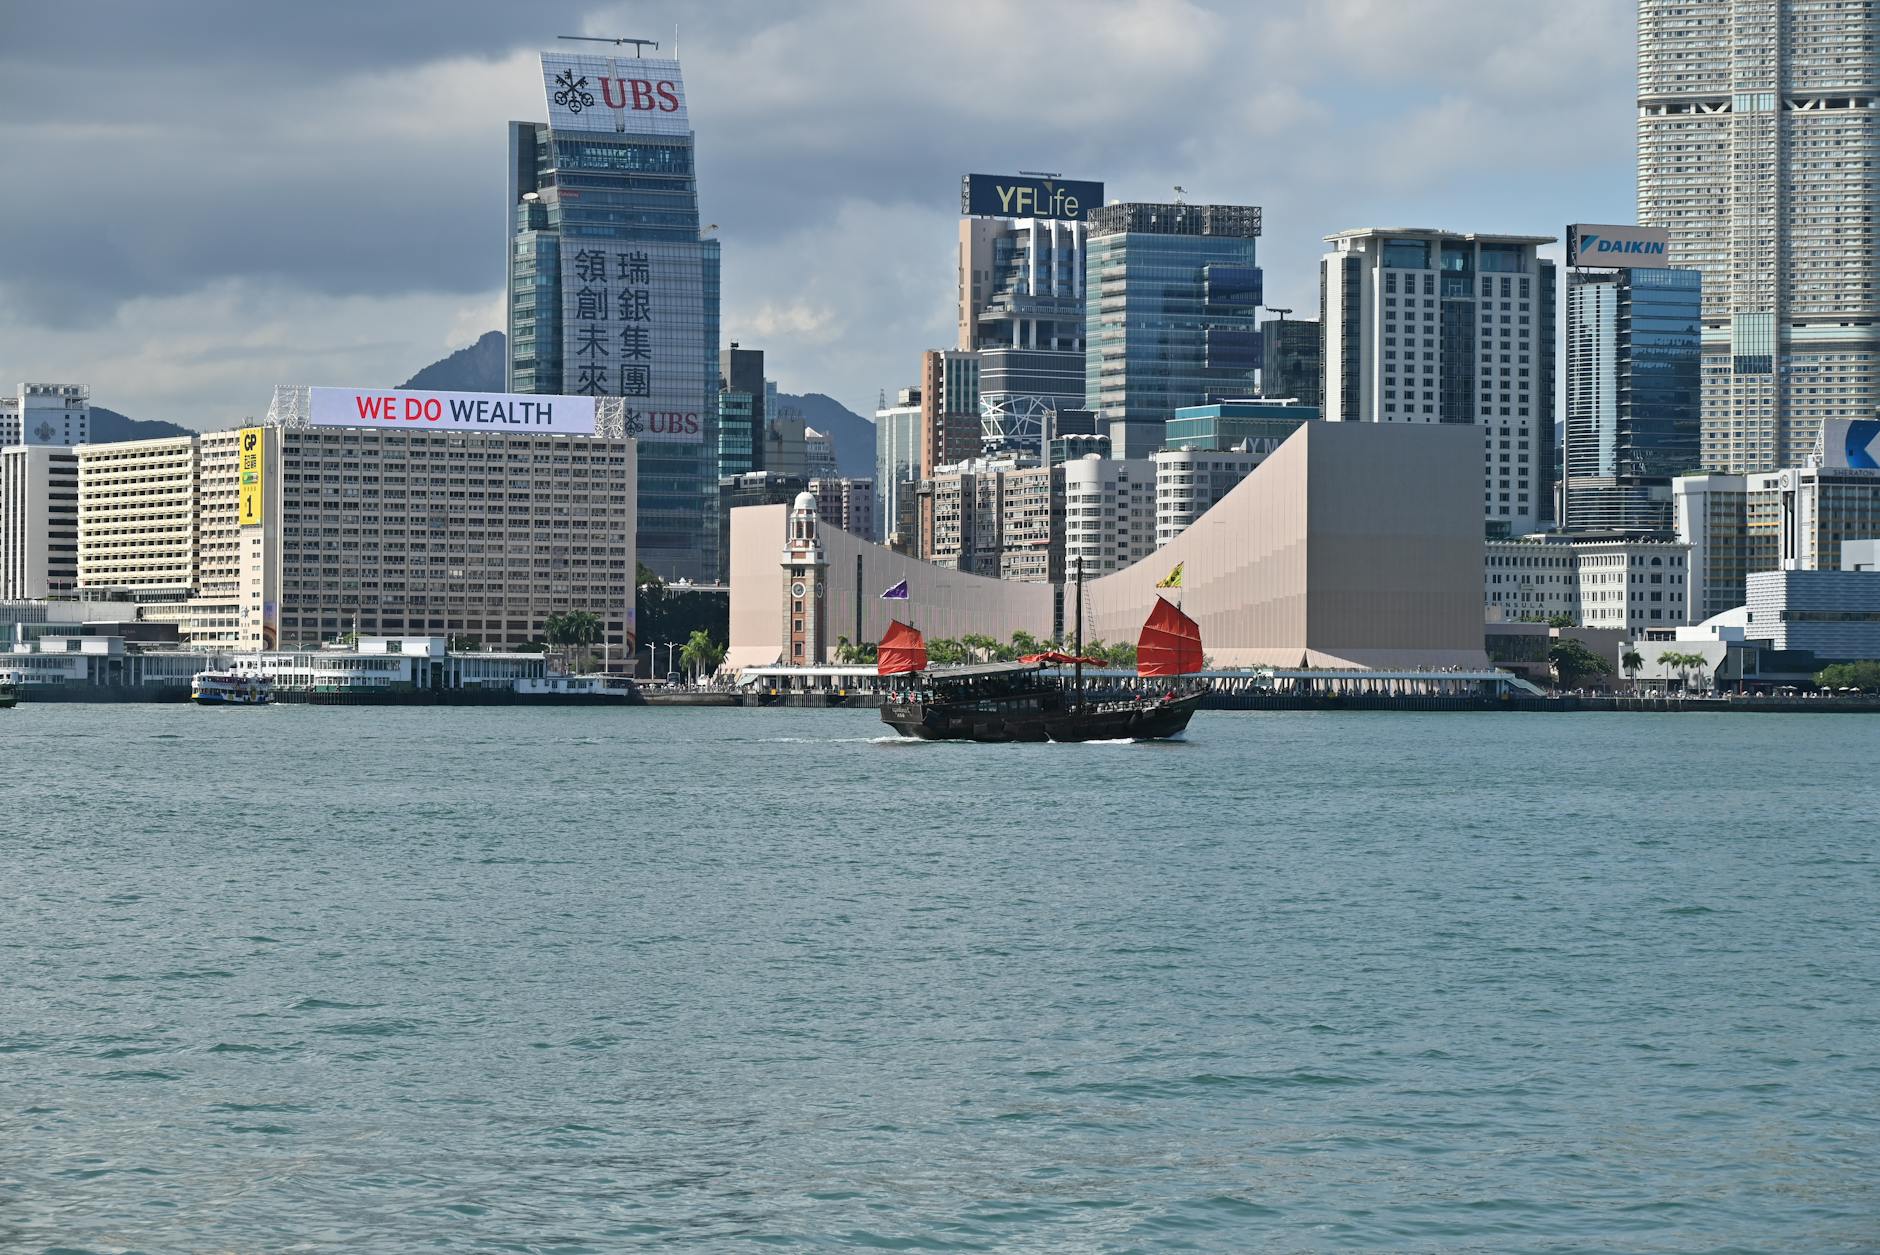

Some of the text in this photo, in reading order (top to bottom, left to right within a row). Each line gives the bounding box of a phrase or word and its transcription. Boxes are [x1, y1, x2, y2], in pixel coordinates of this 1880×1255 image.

[598, 77, 678, 112] UBS
[996, 182, 1079, 217] YFLife
[1597, 240, 1665, 254] DAIKIN
[575, 249, 609, 396] 領創未來
[617, 251, 651, 398] 瑞銀集團
[356, 396, 552, 425] WE DO WEALTH
[648, 412, 698, 434] UBS
[244, 434, 256, 451] GP
[1834, 469, 1875, 477] SHERATON
[246, 495, 253, 517] 1
